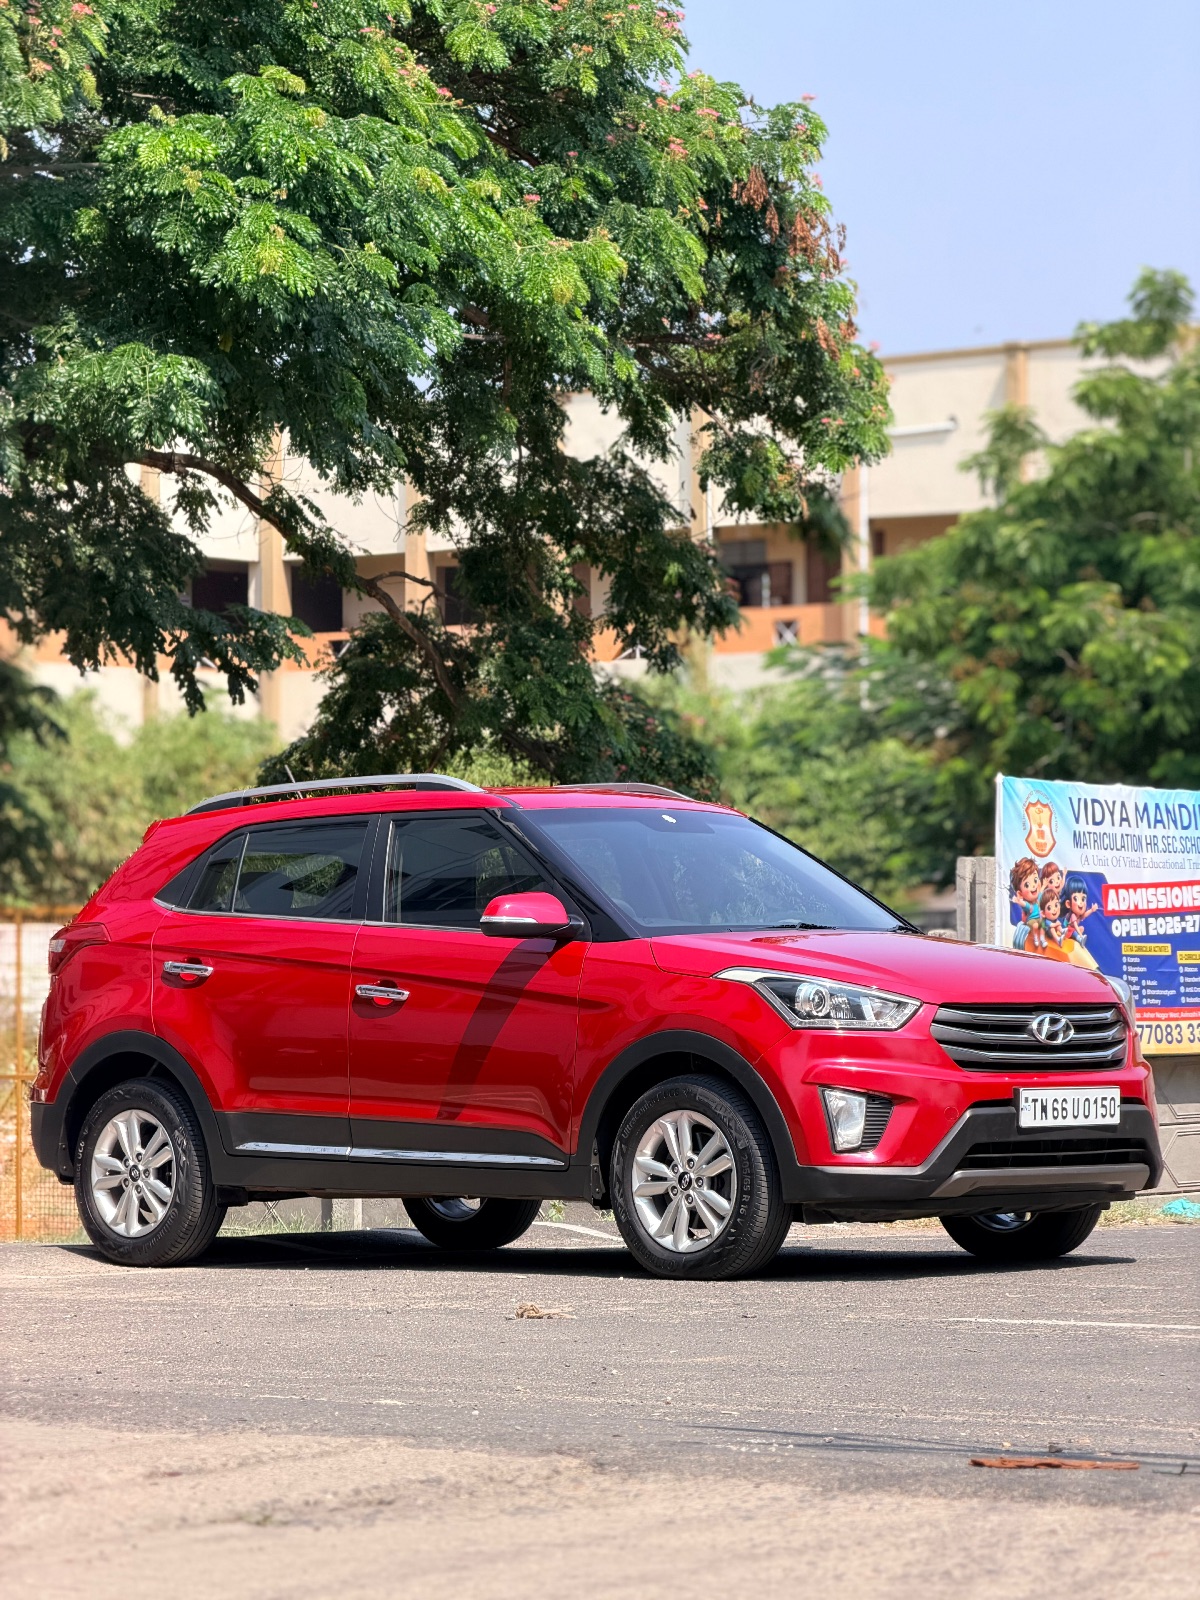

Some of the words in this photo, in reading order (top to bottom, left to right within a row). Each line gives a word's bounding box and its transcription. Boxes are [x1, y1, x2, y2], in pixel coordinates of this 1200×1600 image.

[1068, 796, 1132, 828] VIDYA
[1135, 800, 1200, 831] MANDI
[1072, 830, 1143, 853] MATRICULATION
[1091, 856, 1109, 867] Unit
[1111, 854, 1122, 867] Of
[1122, 856, 1141, 868] Vittal
[1142, 858, 1186, 870] Educational
[1107, 884, 1200, 911] ADMISSIONS
[1111, 916, 1147, 938] OPEN
[1147, 914, 1200, 936] 2026-27
[1136, 1023, 1183, 1045] 77083
